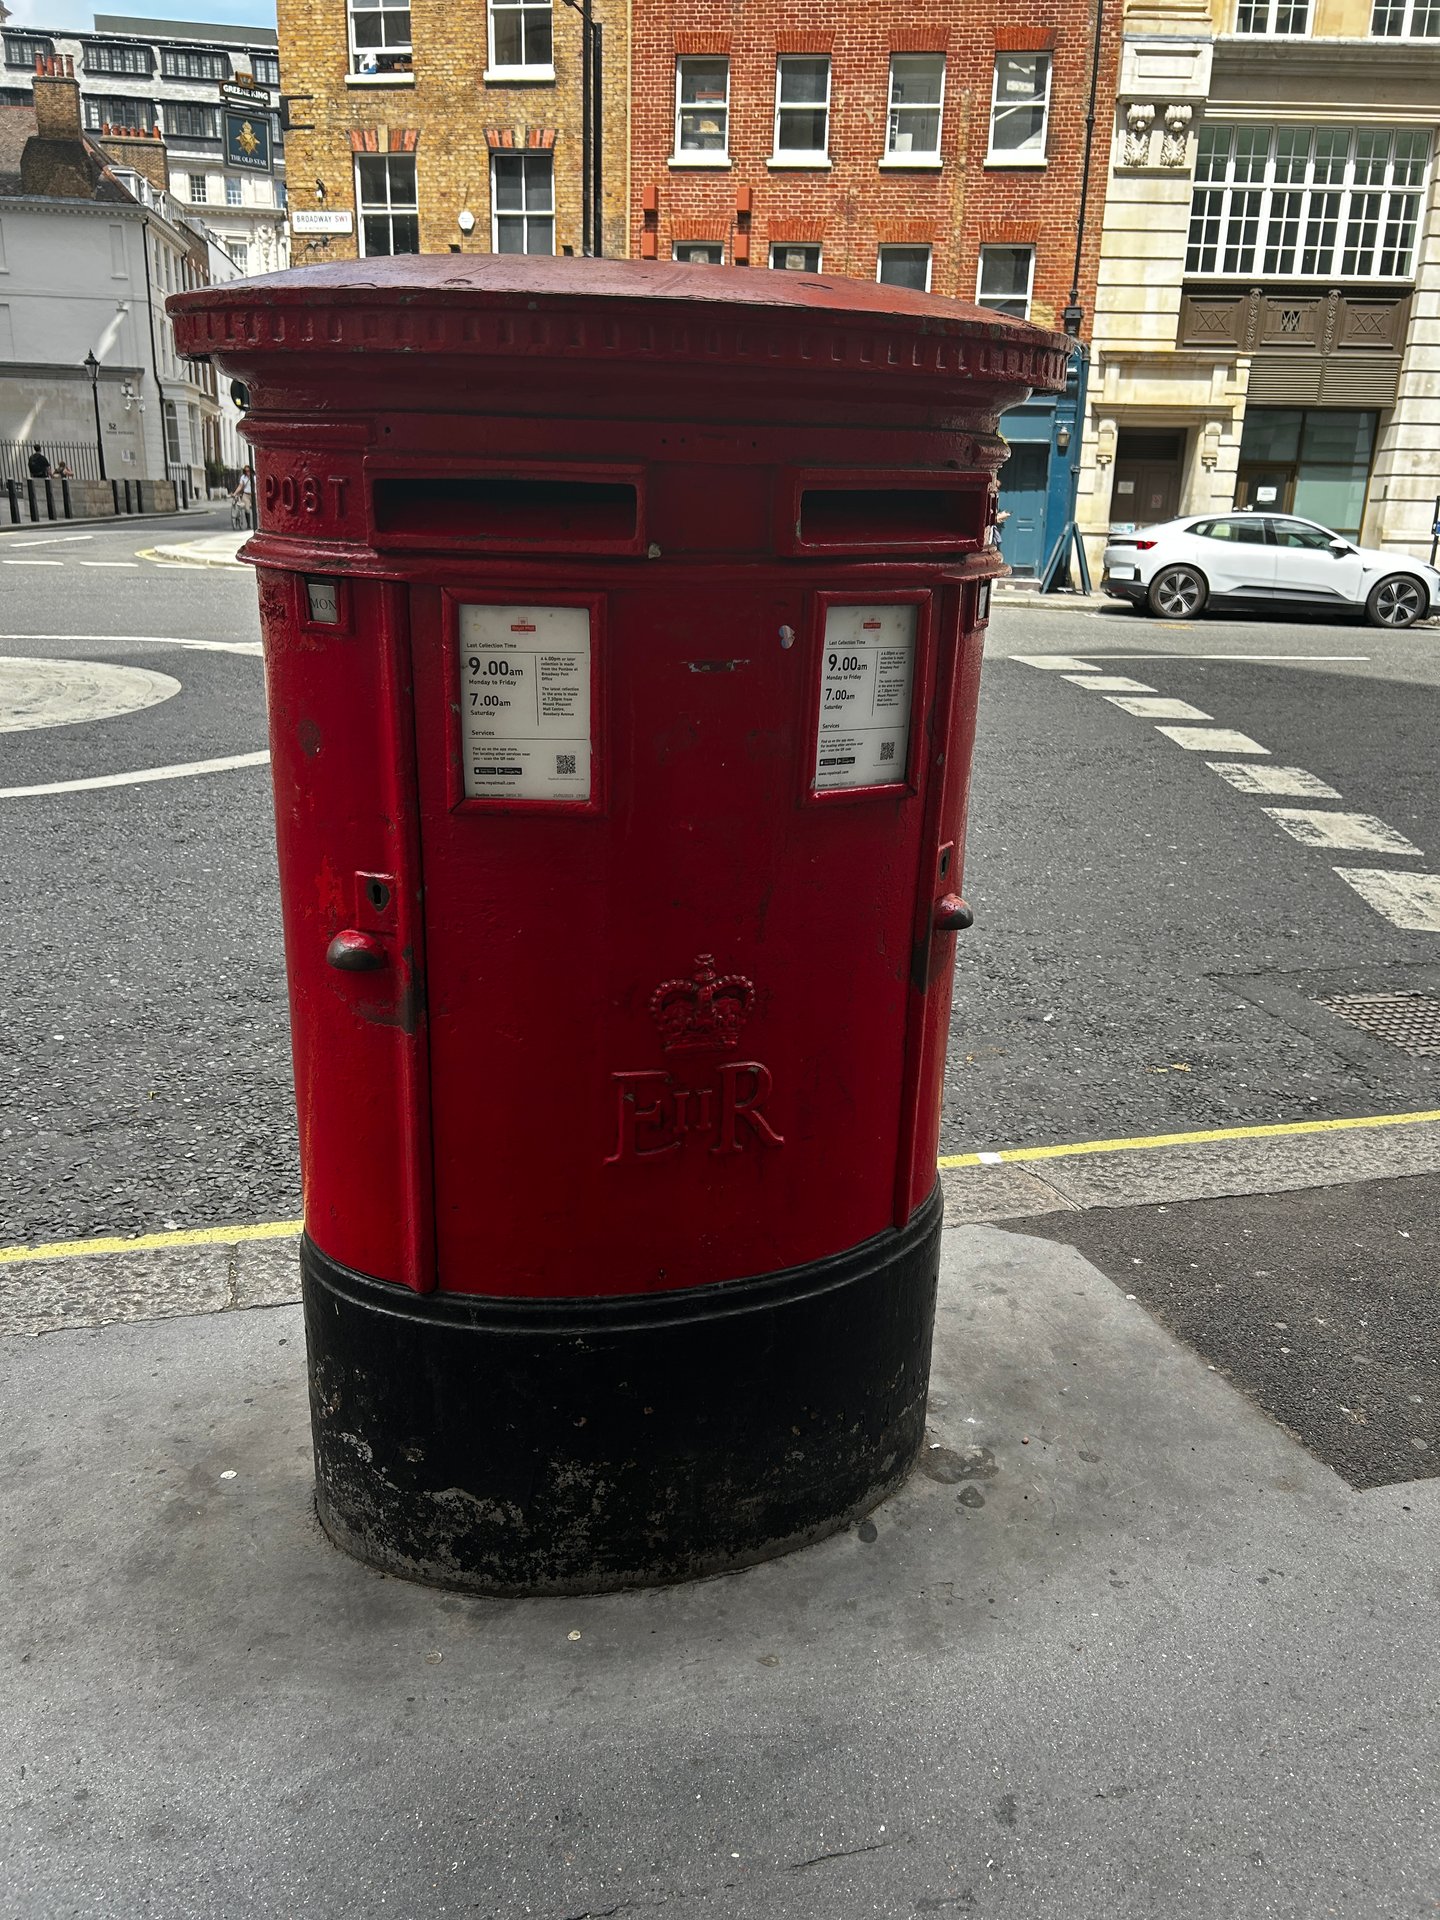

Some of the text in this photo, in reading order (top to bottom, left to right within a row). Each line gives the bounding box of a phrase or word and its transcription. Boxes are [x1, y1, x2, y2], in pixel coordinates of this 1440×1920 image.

[223, 85, 268, 100] GREENE KING
[230, 154, 242, 162] THE
[254, 158, 267, 166] STAR
[297, 215, 332, 223] BROADWAY
[108, 422, 116, 430] 52
[265, 475, 349, 519] POST
[310, 598, 336, 610] MON
[468, 657, 523, 676] 9.00am
[828, 654, 867, 671] 9.00am
[470, 693, 511, 706] 7.00am
[826, 688, 855, 701] 7.00am
